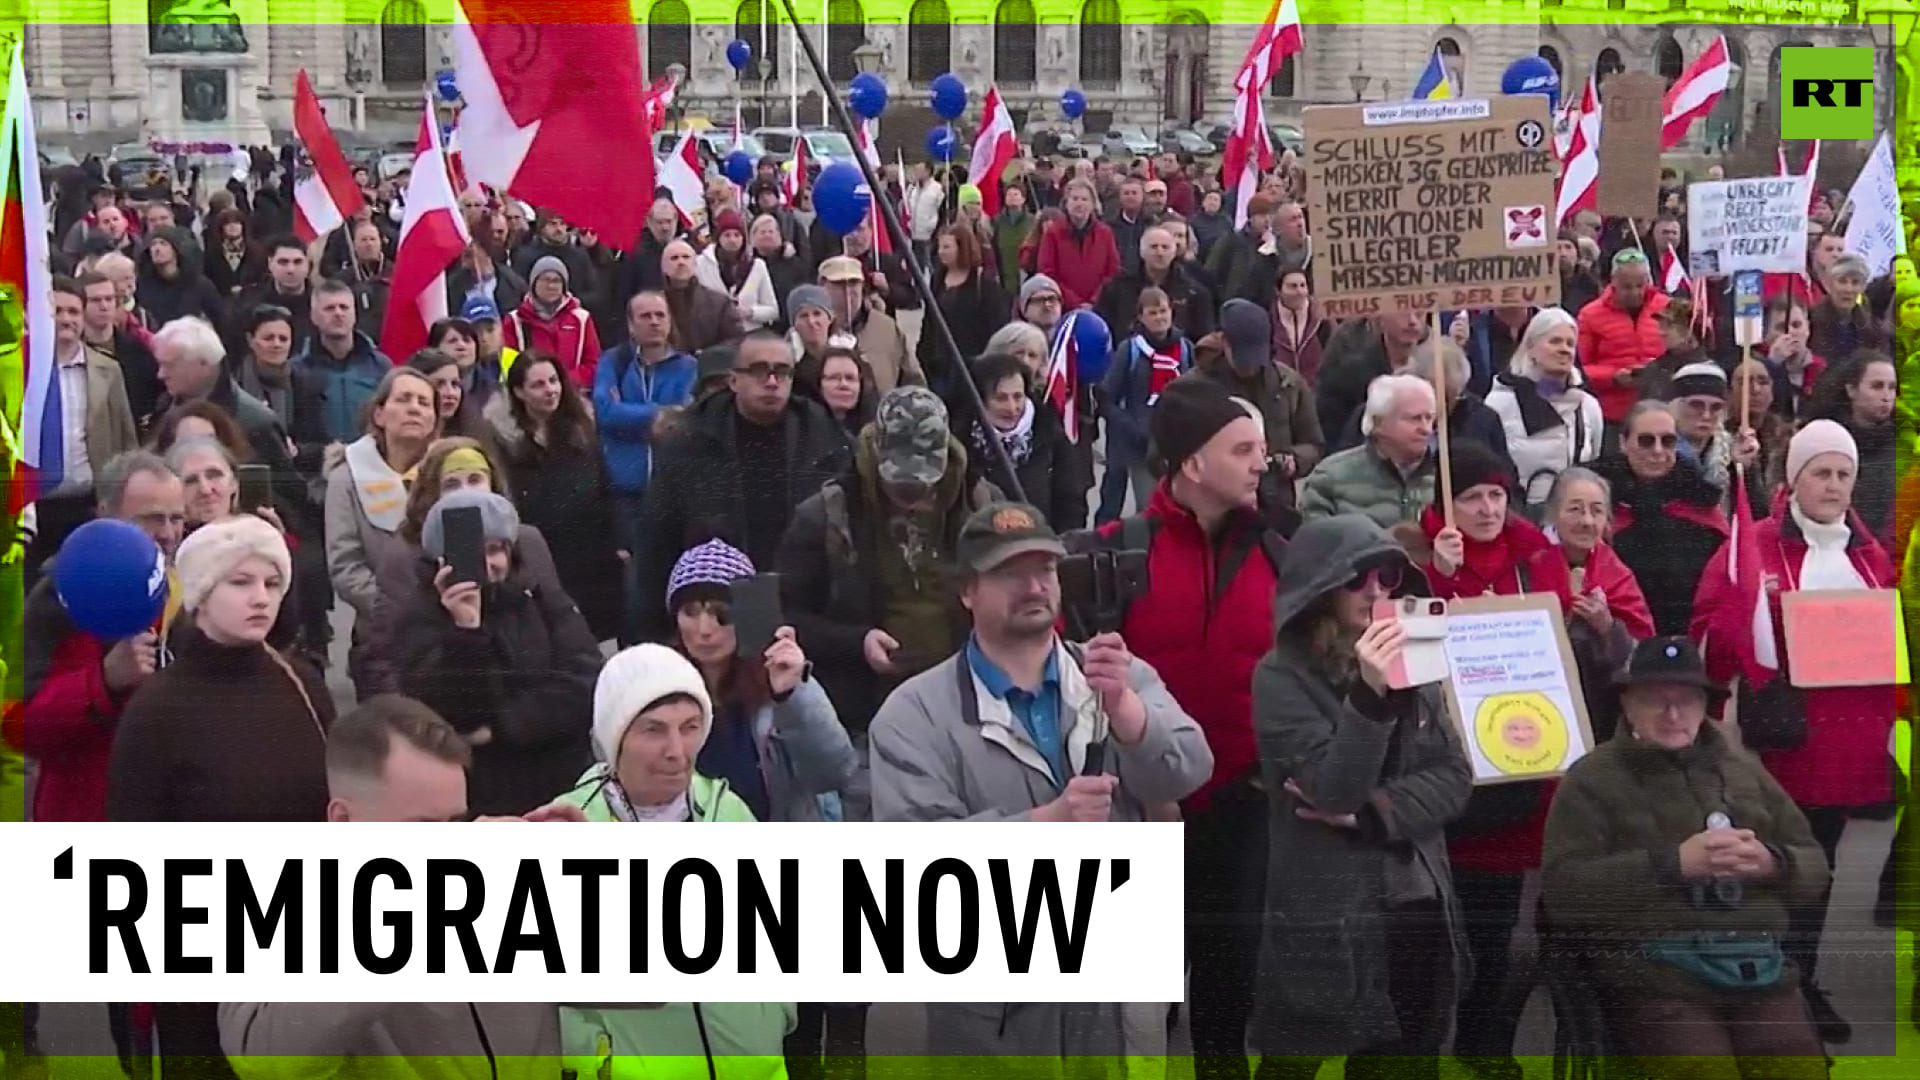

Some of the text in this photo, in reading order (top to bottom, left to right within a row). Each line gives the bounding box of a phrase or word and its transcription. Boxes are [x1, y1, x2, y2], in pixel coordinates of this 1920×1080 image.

[1313, 133, 1446, 164] SCHLUSS
[1447, 150, 1552, 179] GENSPRITZE
[1417, 182, 1491, 207] ORDER
[1727, 181, 1796, 200] UNRECHT
[1324, 297, 1381, 317] RAUS
[1394, 291, 1438, 311] AUS
[1452, 288, 1494, 306] DER
